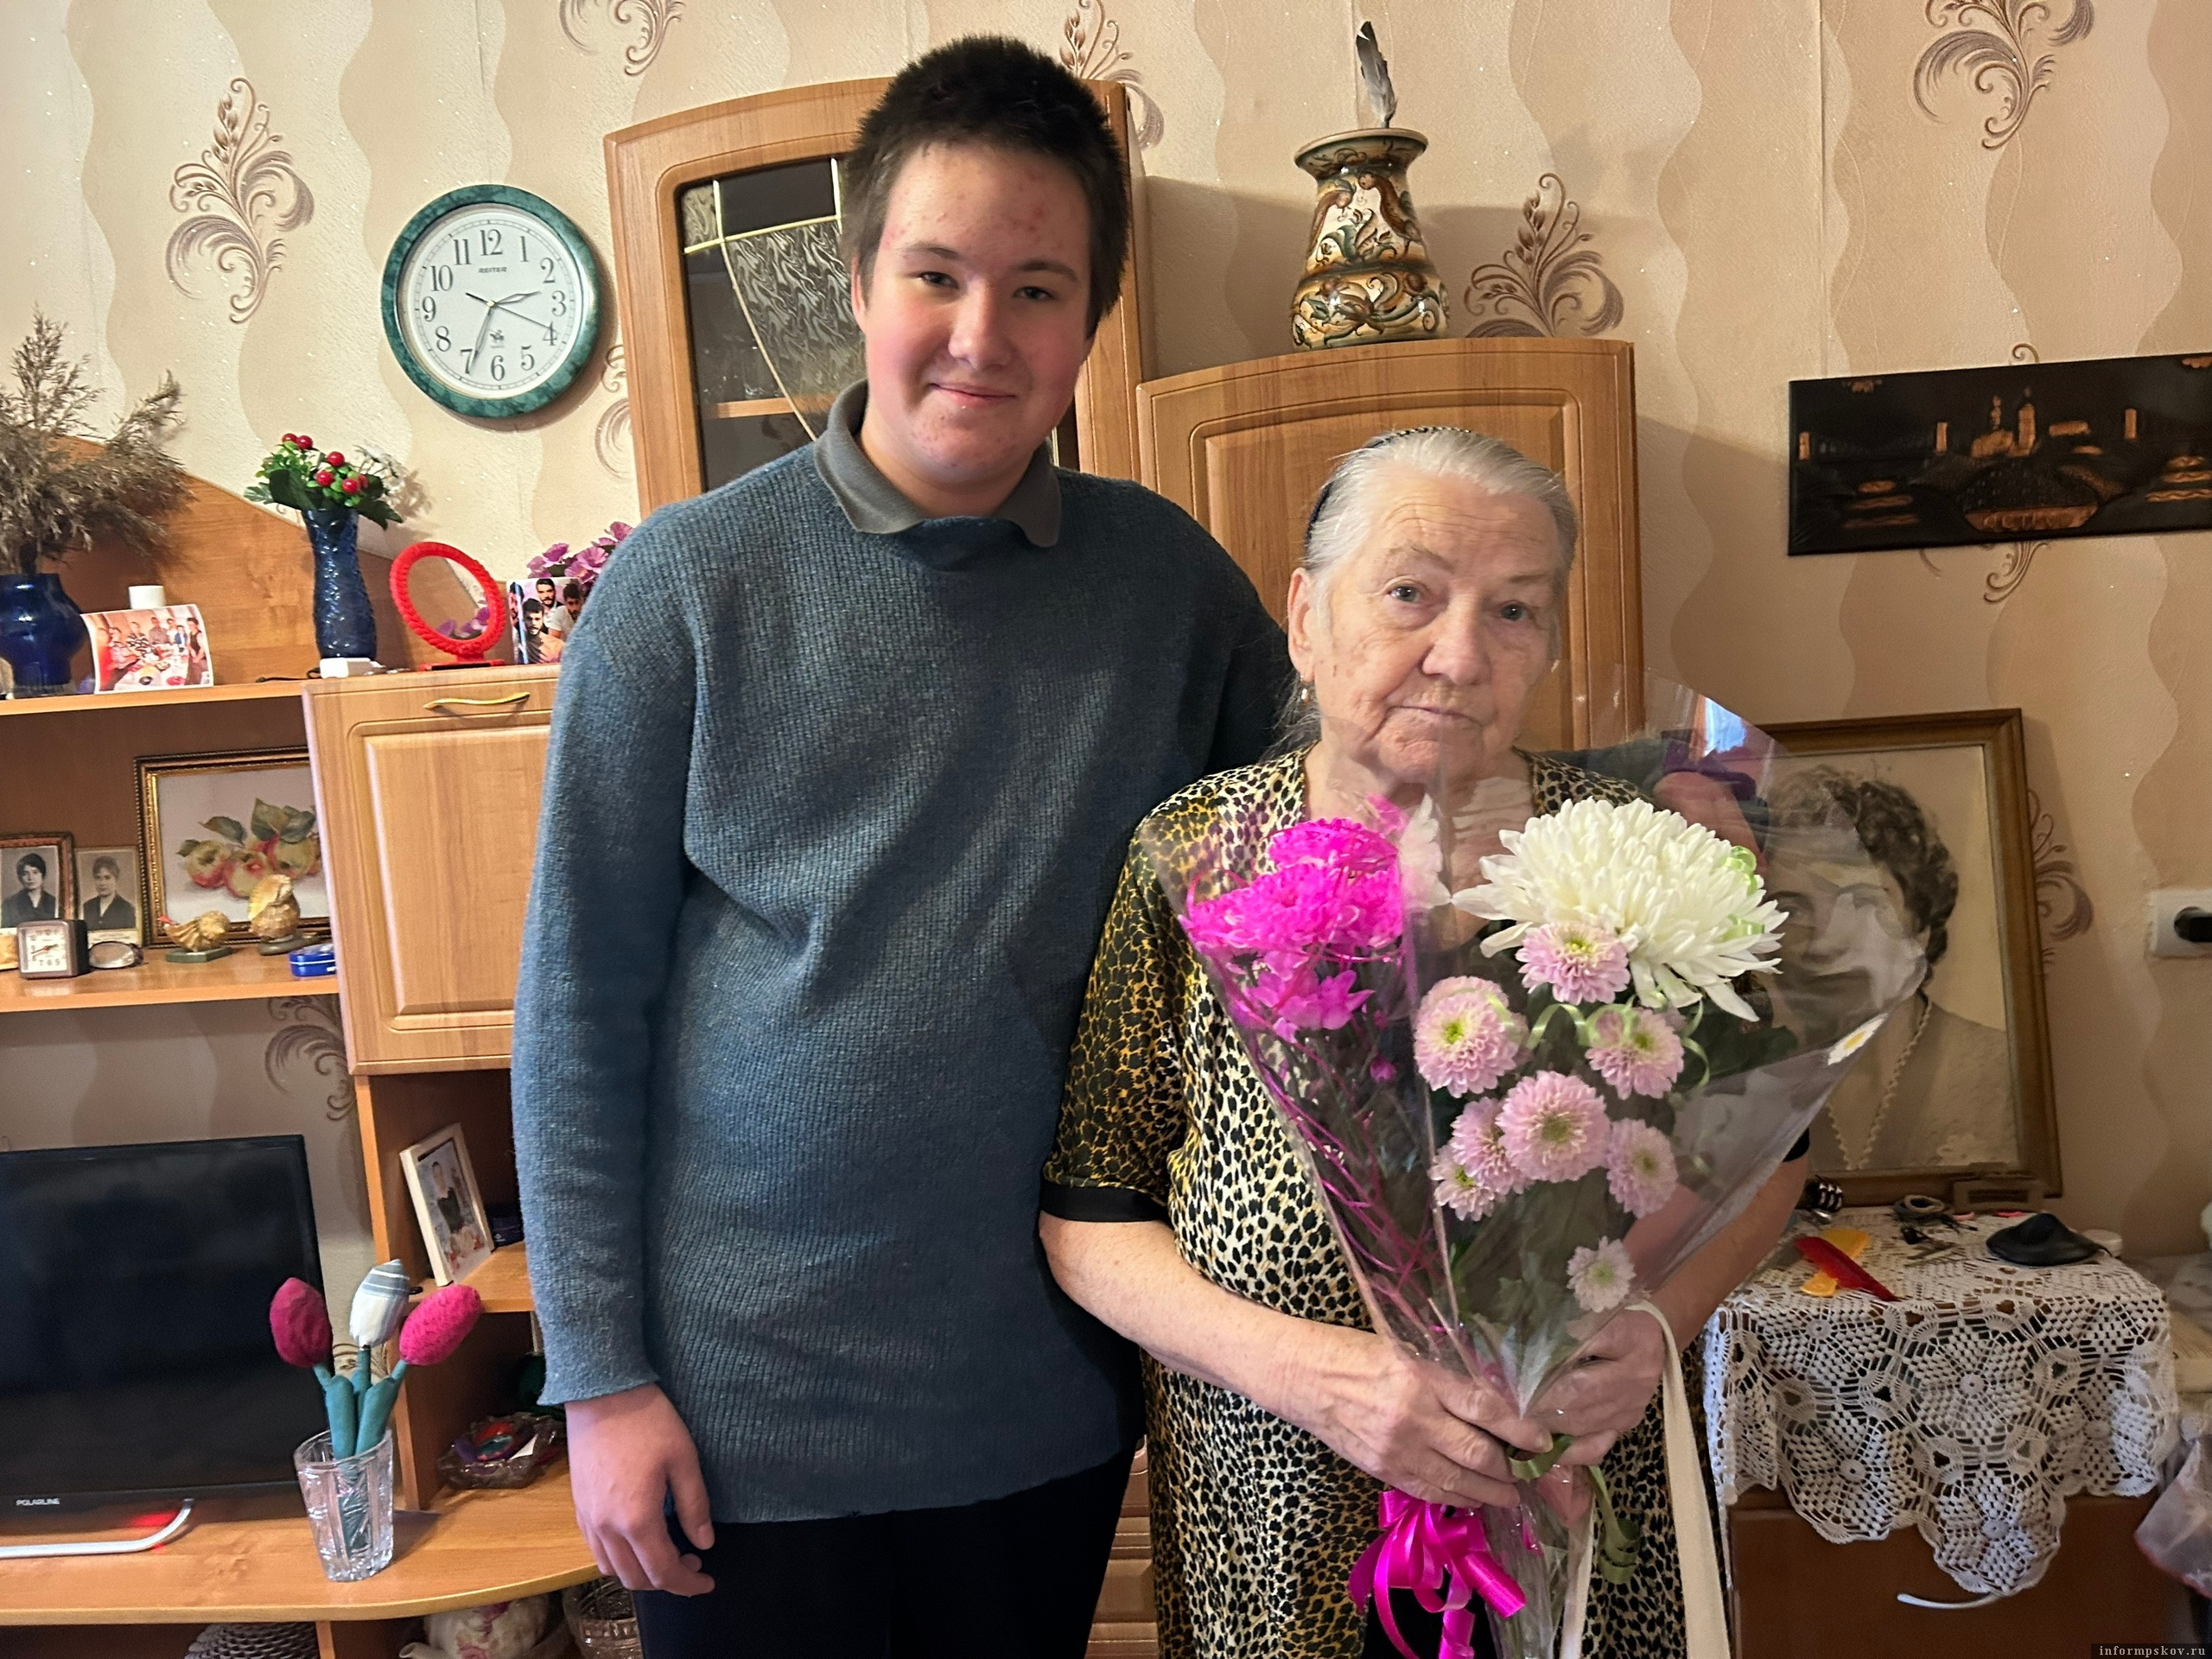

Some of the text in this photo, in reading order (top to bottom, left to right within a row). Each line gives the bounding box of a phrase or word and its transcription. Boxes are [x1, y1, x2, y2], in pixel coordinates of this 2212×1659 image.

[453, 238, 472, 265] 11
[480, 229, 503, 257] 12
[520, 236, 529, 263] 1
[430, 264, 454, 292] 10
[540, 257, 556, 284] 2
[422, 296, 436, 322] 9
[551, 290, 567, 317] 3
[435, 326, 452, 352] 8
[543, 321, 558, 346] 4
[460, 348, 474, 375] 7
[490, 355, 505, 381] 6
[520, 345, 535, 371] 5
[16, 1497, 60, 1506] POLARLINE
